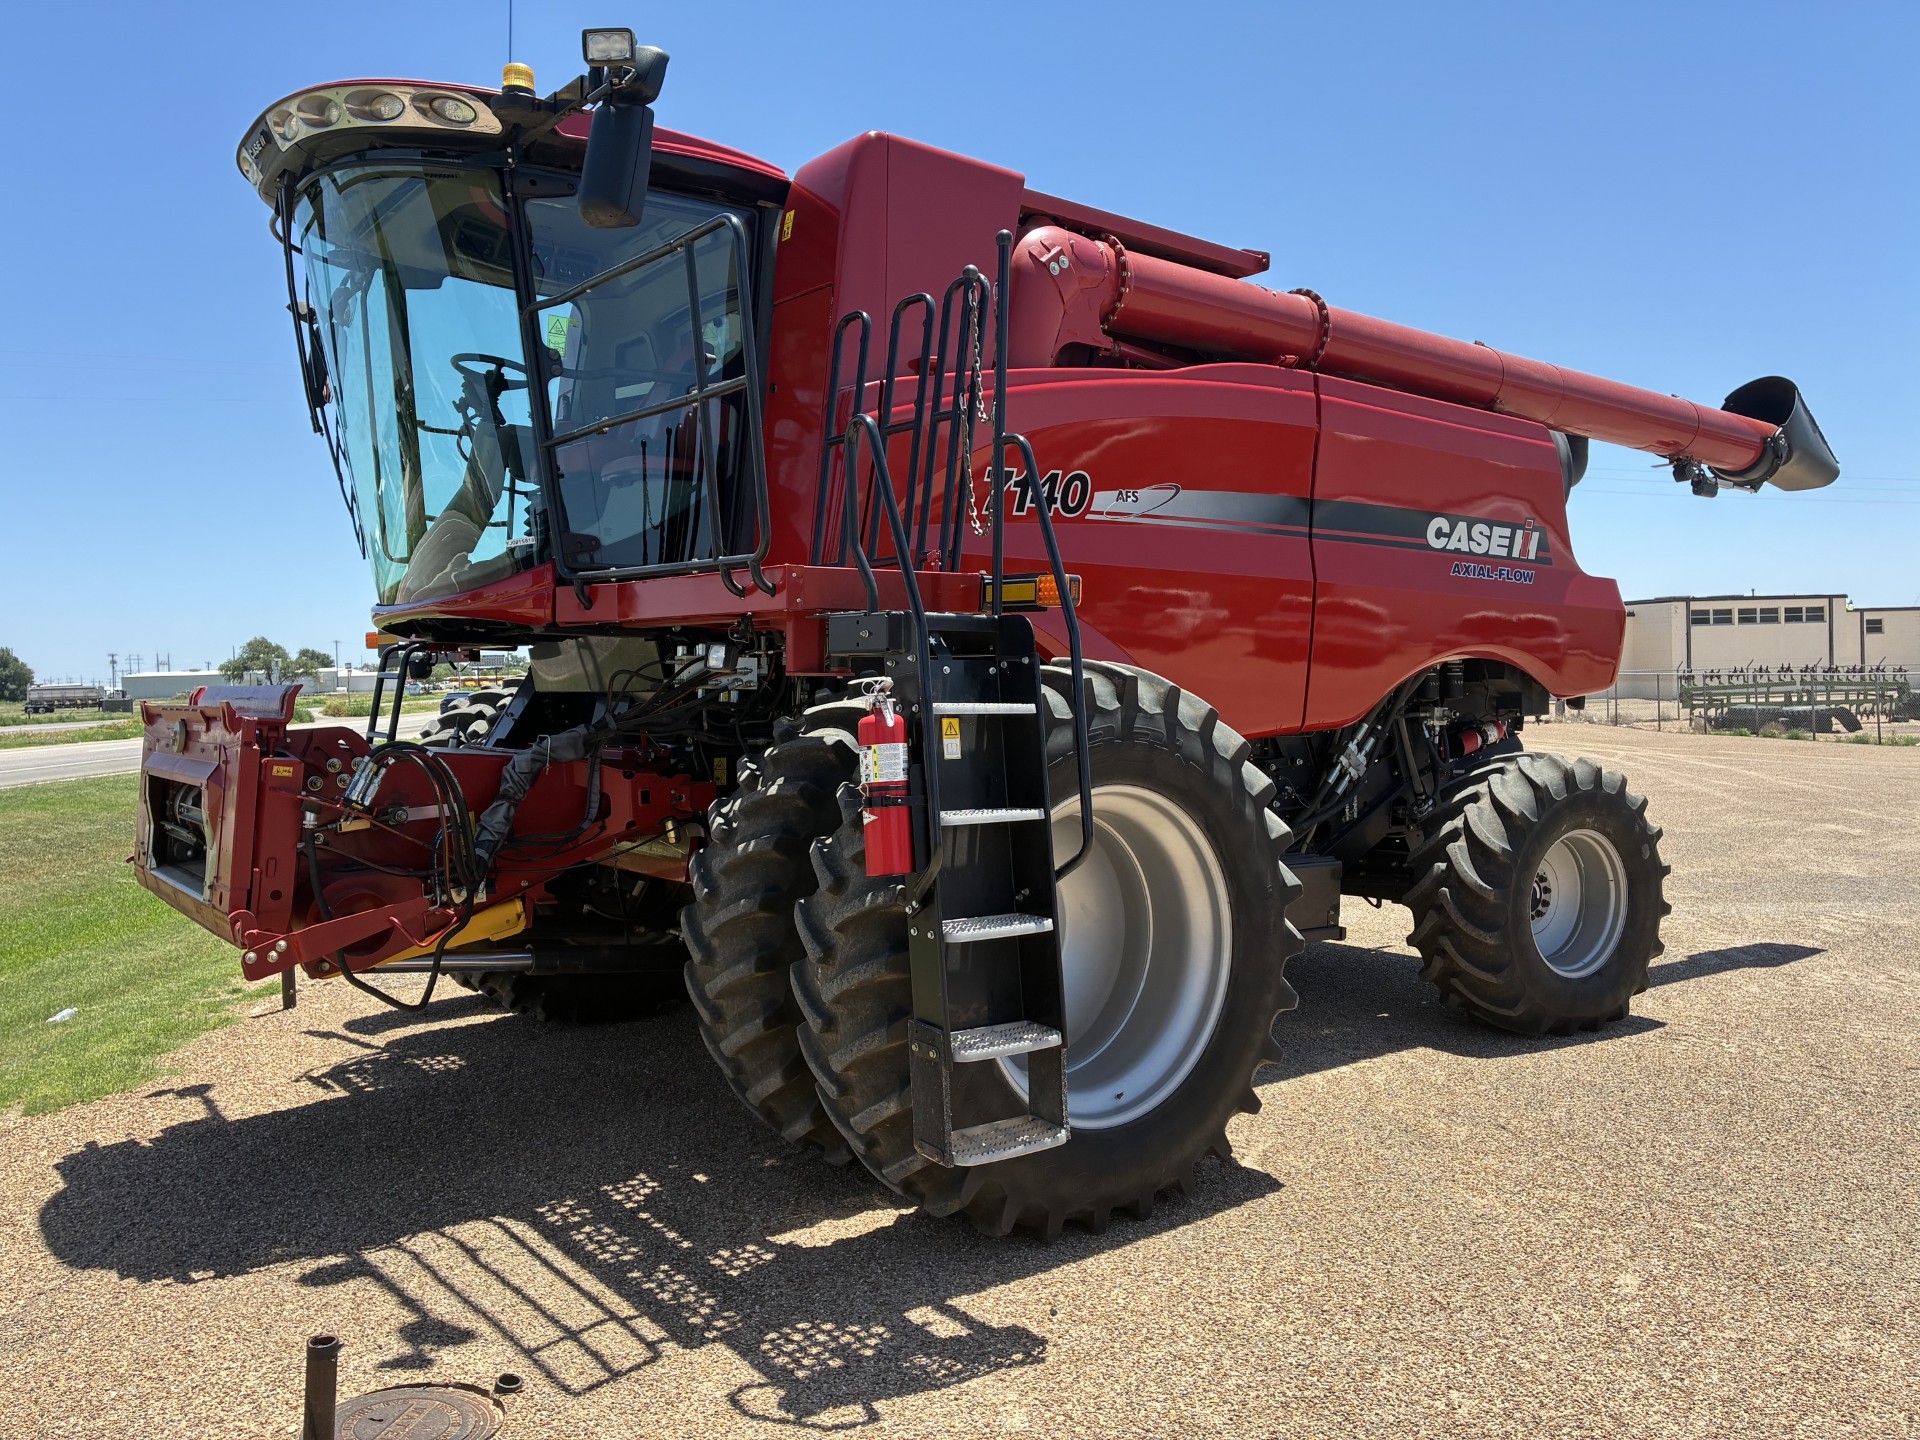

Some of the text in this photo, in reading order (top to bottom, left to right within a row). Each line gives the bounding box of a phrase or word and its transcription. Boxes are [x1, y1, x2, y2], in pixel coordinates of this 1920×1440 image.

[982, 467, 1091, 517] 7140
[1115, 490, 1139, 503] AFS
[1426, 516, 1511, 557] CASE
[1450, 561, 1535, 585] AXIAL-FLOW
